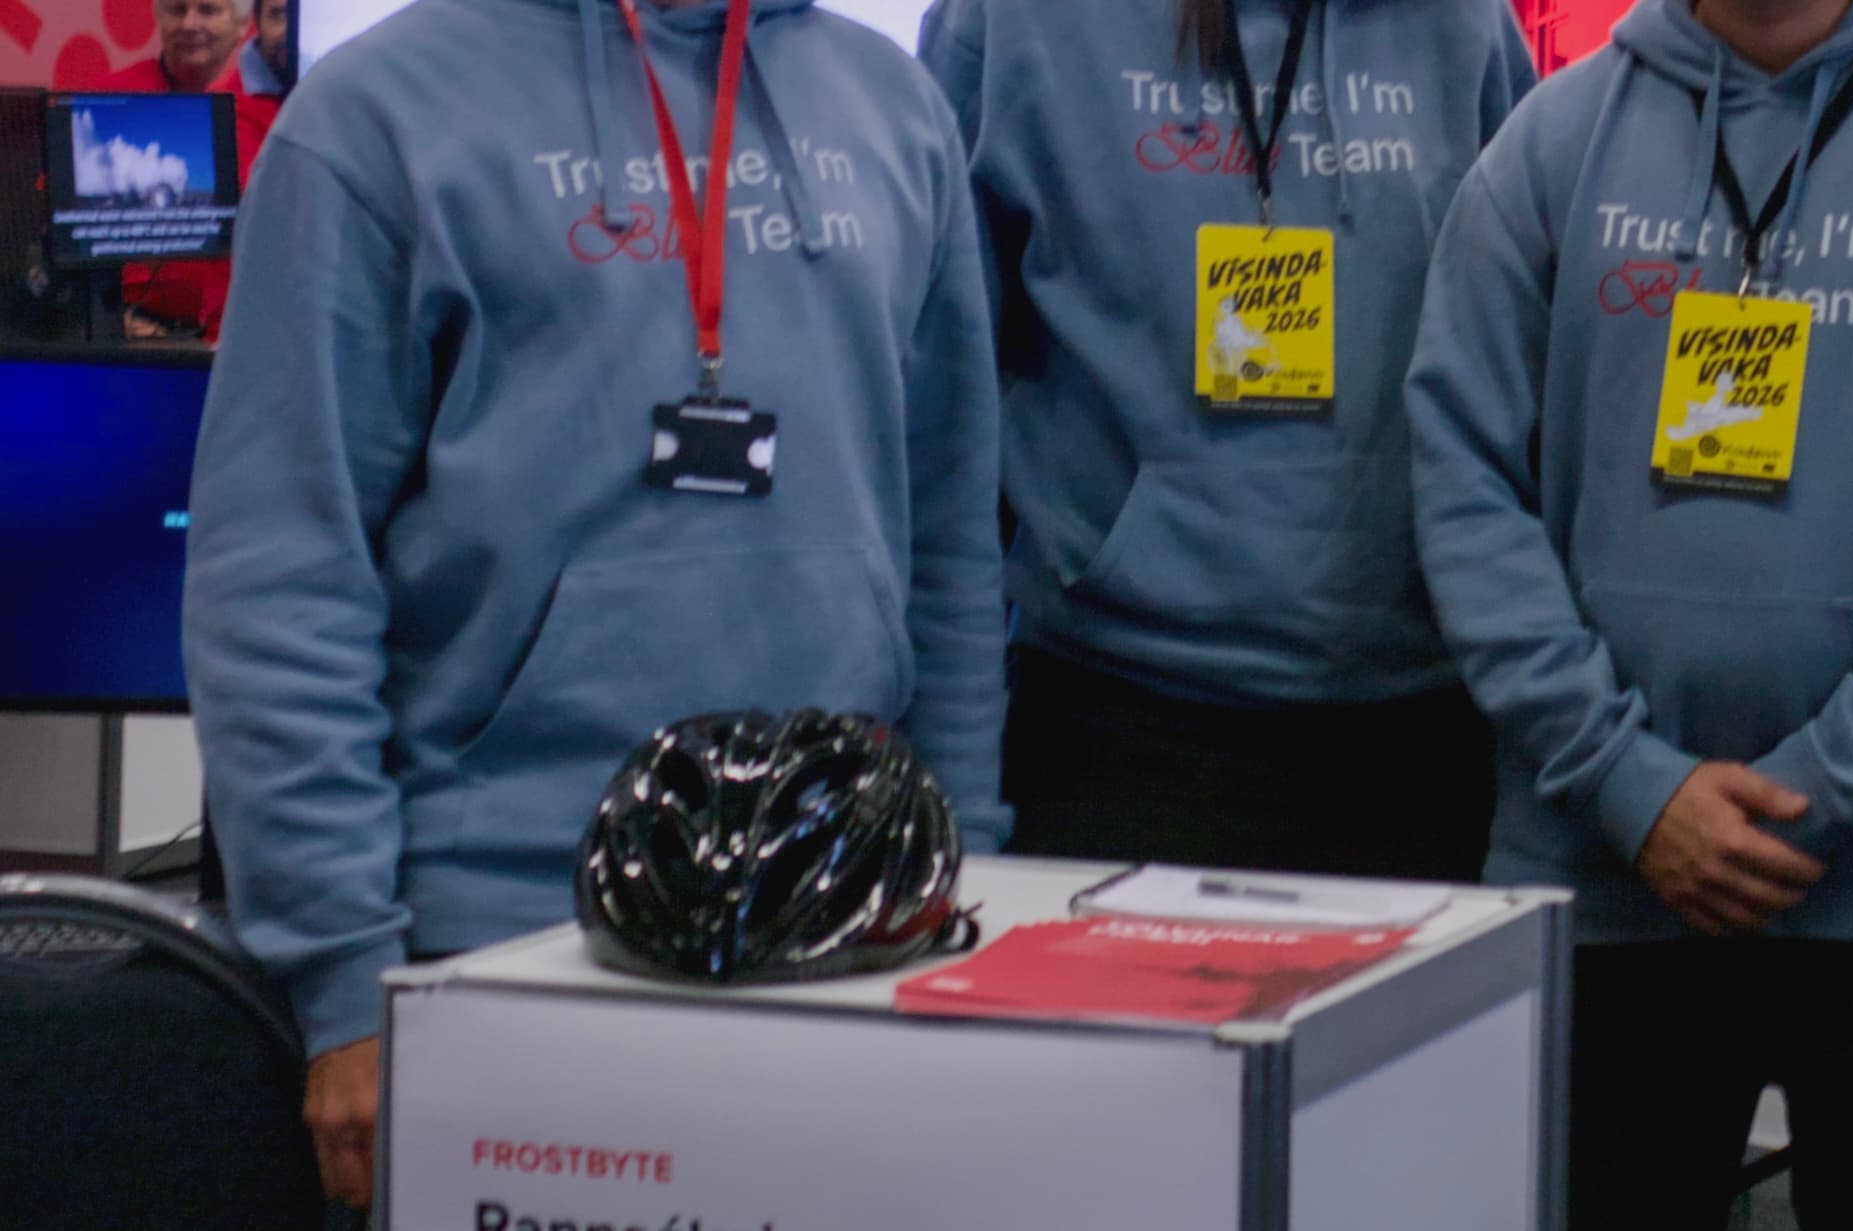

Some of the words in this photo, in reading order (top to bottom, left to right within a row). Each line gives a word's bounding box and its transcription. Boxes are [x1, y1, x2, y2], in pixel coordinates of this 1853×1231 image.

[1346, 71, 1415, 115] I'm
[1287, 131, 1415, 178] Team
[728, 203, 864, 256] Tem
[1232, 279, 1301, 313] VAKA
[1264, 306, 1323, 335] 2026
[1697, 353, 1773, 386] VAKA
[1728, 381, 1789, 408] 2026
[471, 1136, 674, 1185] FROSTBYTE
